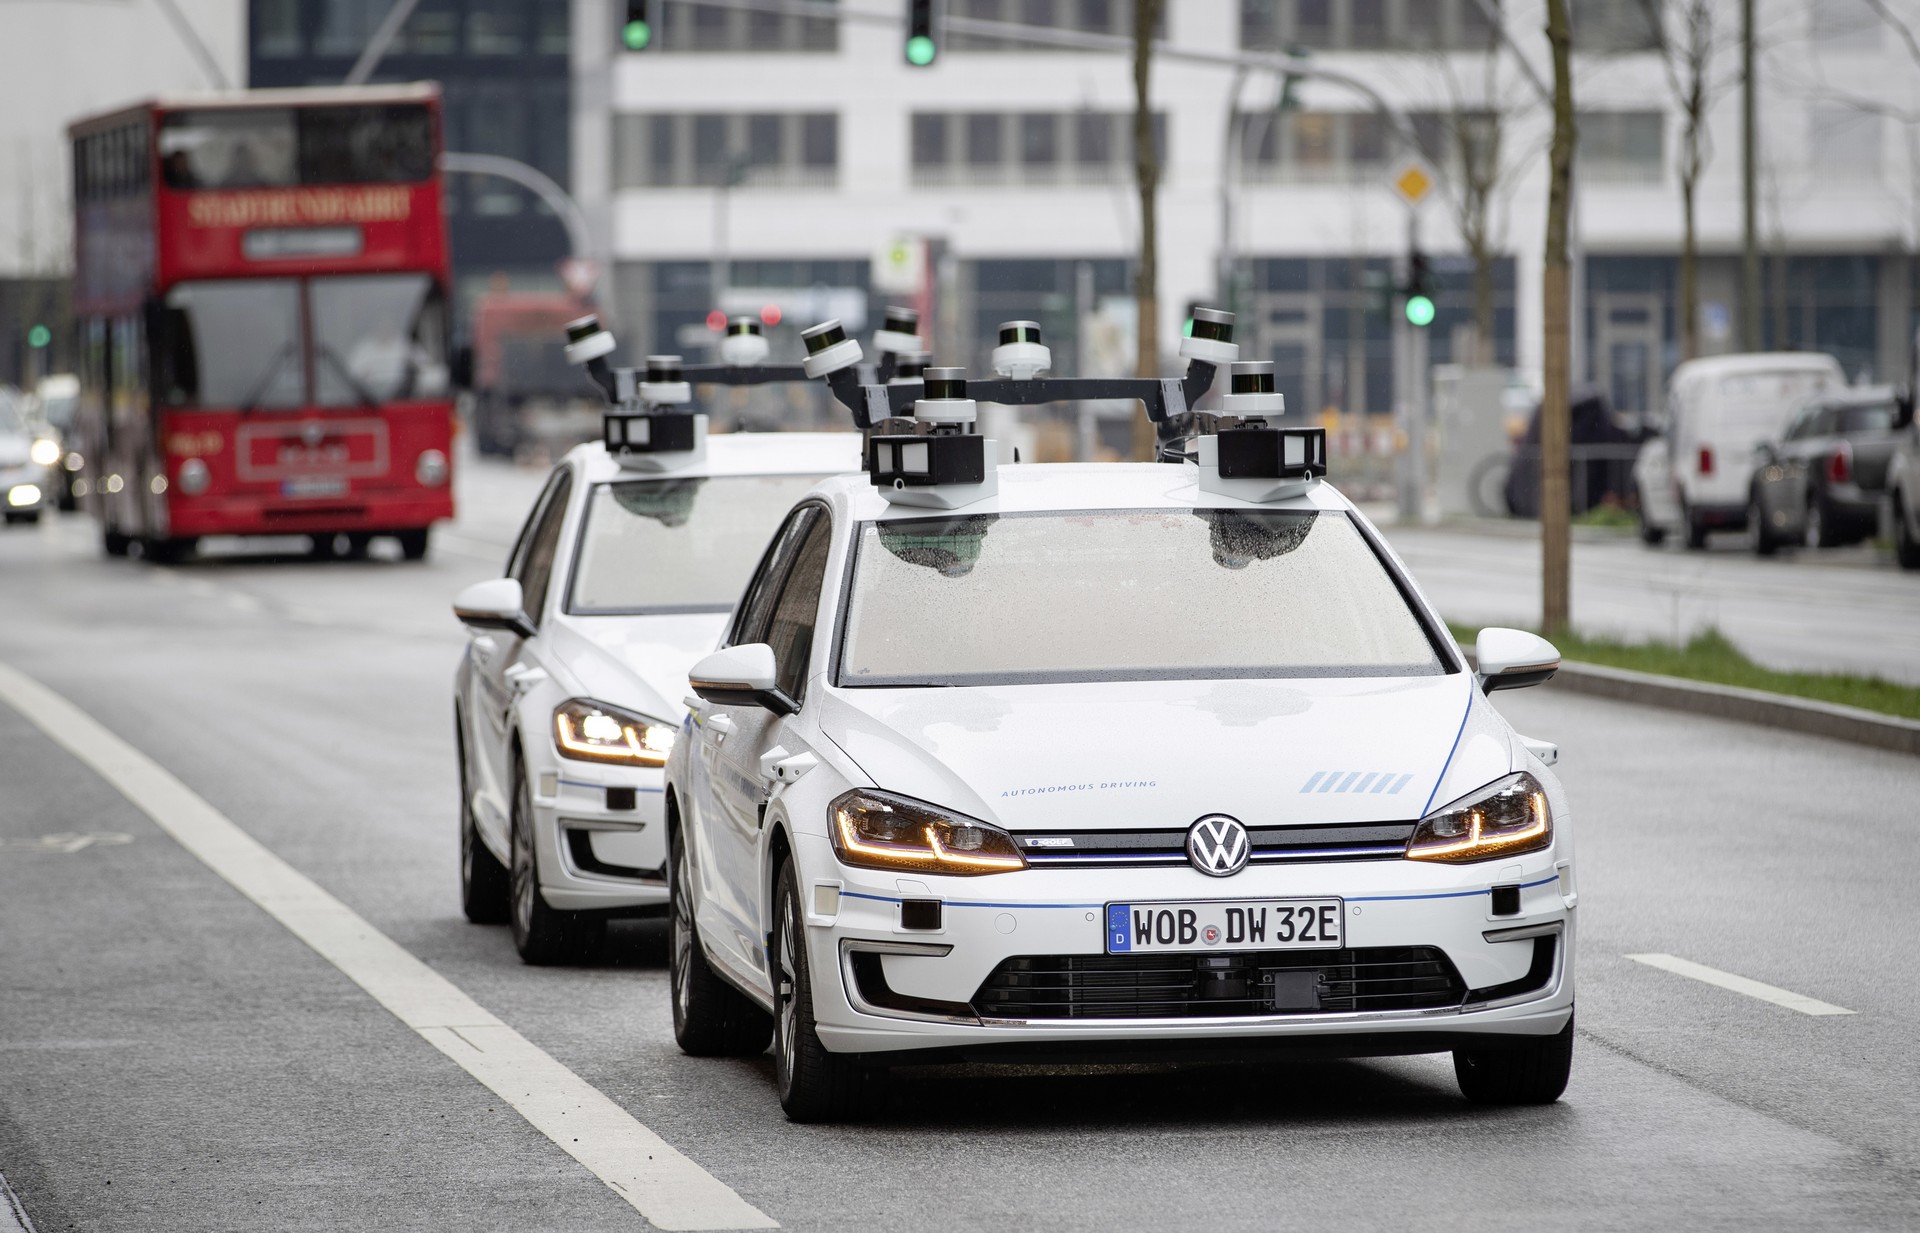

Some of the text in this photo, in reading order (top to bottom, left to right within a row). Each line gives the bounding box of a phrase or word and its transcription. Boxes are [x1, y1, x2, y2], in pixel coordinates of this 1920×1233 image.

[1001, 780, 1157, 798] AUTONOMOUS DRIVING
[1191, 817, 1248, 873] VW
[1115, 933, 1125, 944] D
[1133, 905, 1339, 945] WOB DW 32E
